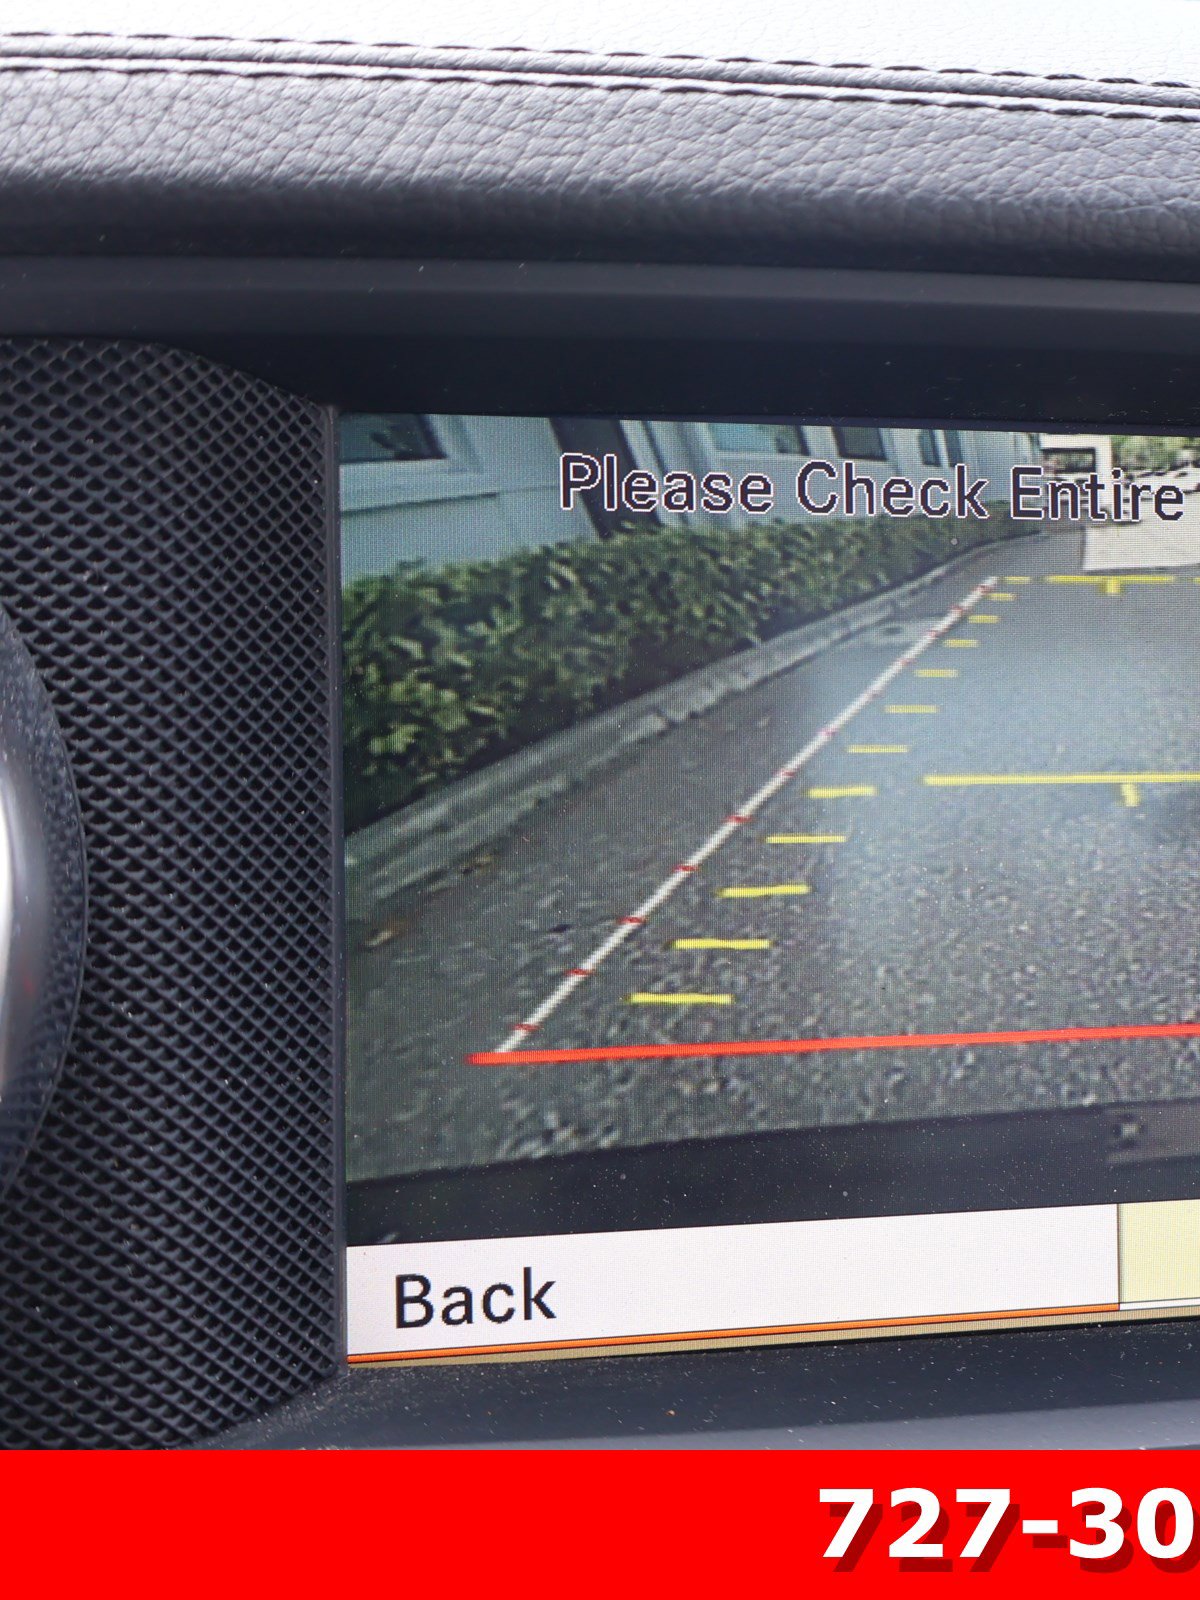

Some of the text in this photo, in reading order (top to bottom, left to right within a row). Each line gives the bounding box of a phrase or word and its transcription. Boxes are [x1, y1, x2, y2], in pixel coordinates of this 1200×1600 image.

[559, 452, 774, 513] Please
[796, 459, 990, 519] Check
[1010, 465, 1185, 522] Entire
[395, 1266, 557, 1329] Back
